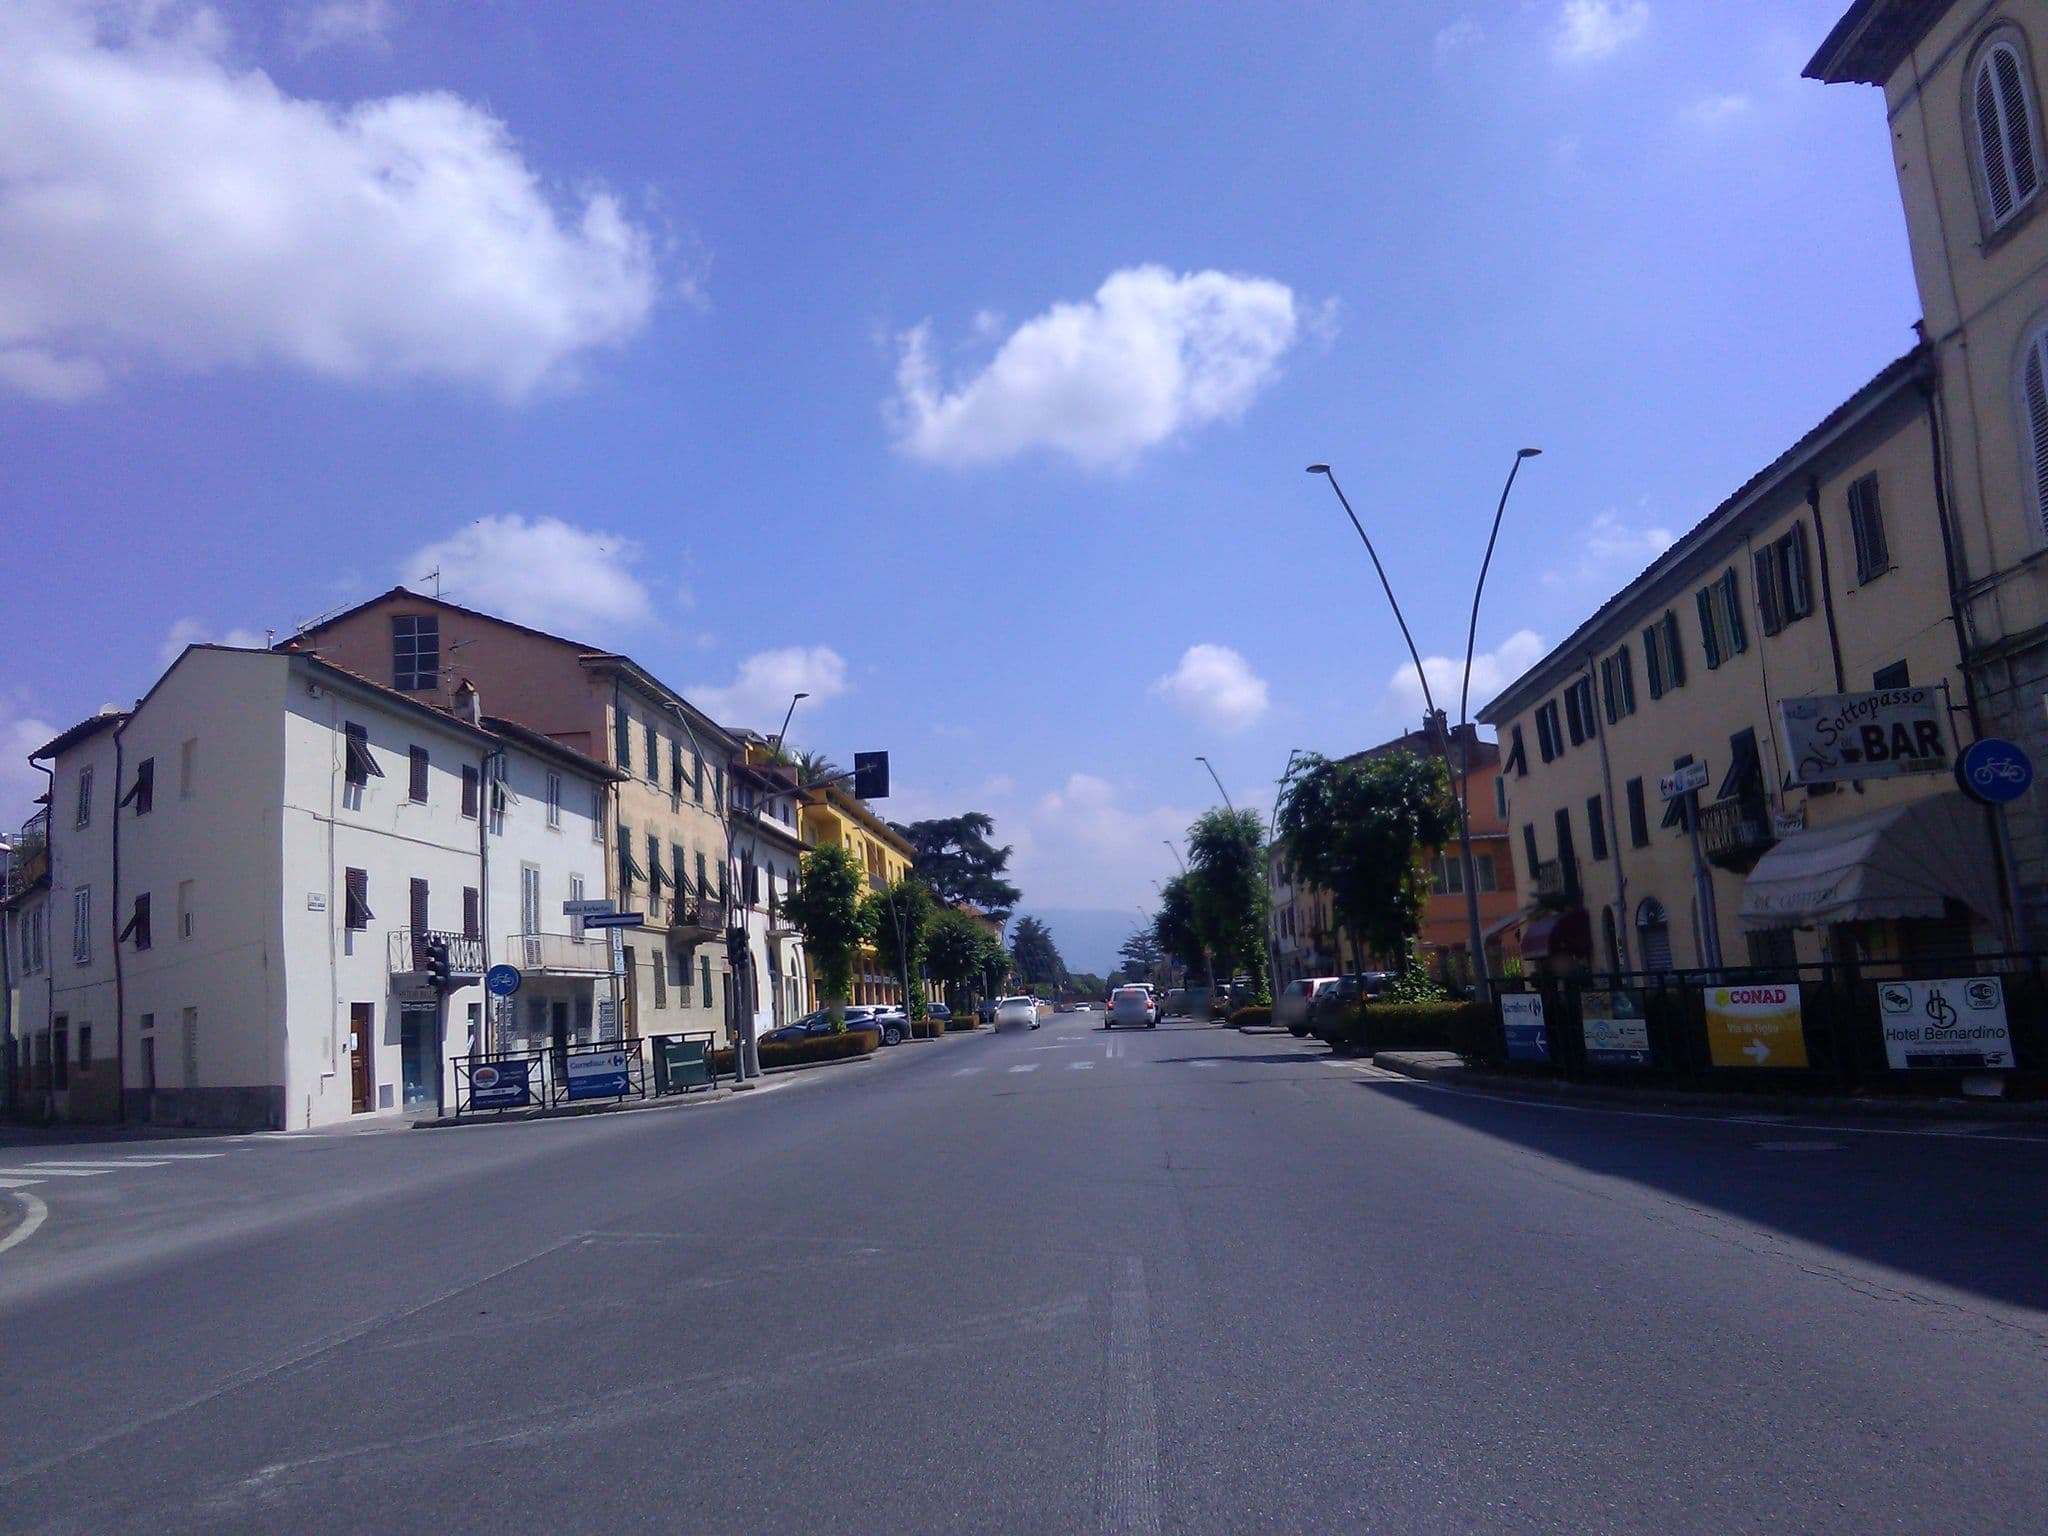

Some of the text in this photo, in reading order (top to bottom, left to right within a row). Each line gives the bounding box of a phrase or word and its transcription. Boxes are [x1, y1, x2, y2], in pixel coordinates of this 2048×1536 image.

[1816, 690, 1925, 747] Sottopasso
[1859, 719, 1945, 762] BAR
[1730, 989, 1787, 1005] CONAD
[1885, 1024, 2006, 1042] Hotel Bernardino
